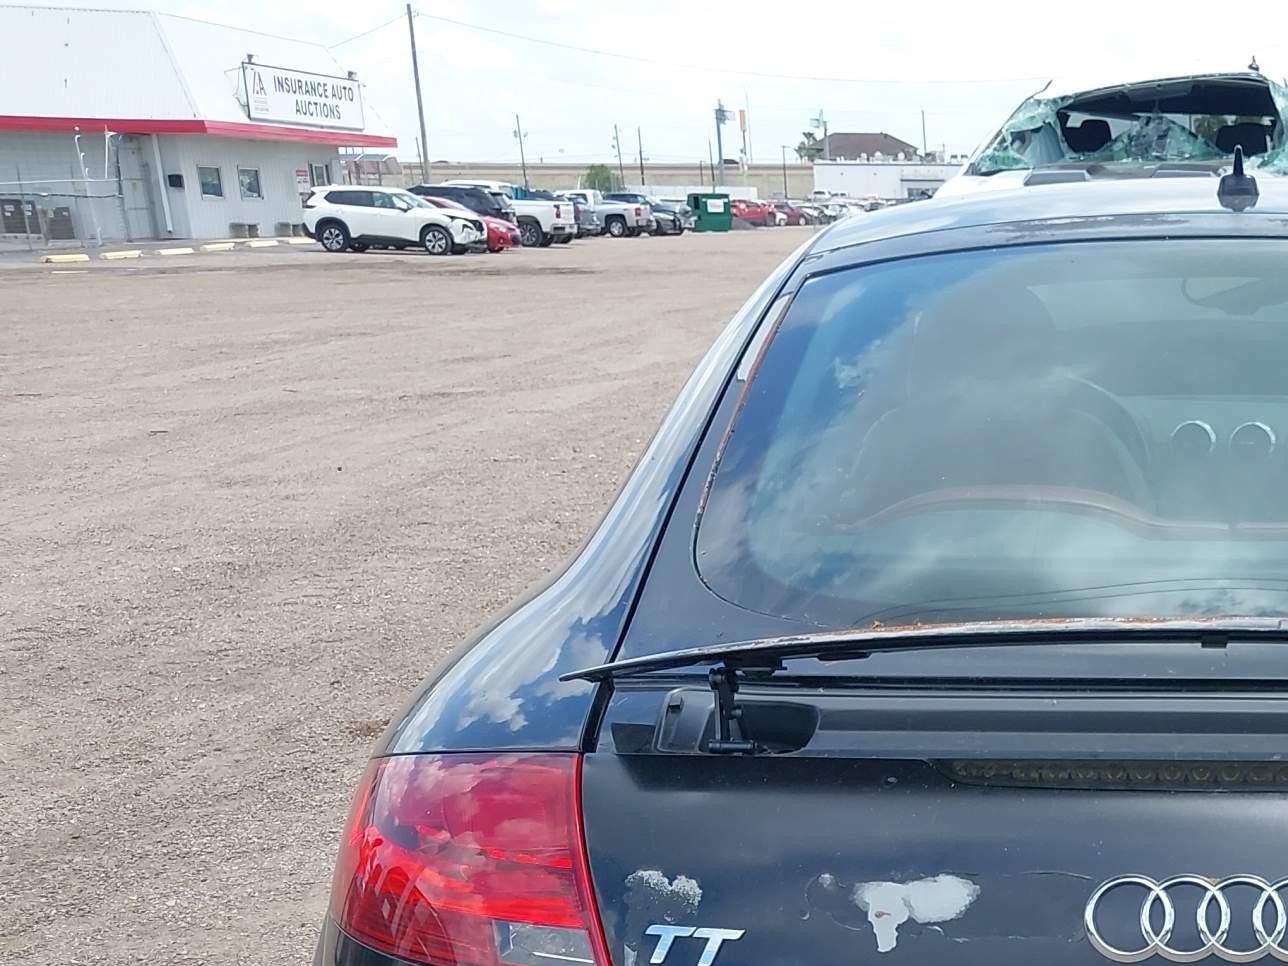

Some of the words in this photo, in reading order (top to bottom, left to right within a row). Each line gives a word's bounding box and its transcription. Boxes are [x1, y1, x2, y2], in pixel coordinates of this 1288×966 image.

[273, 75, 329, 99] INSURANCE
[331, 84, 354, 102] AUTO
[295, 99, 341, 120] AUCTIONS
